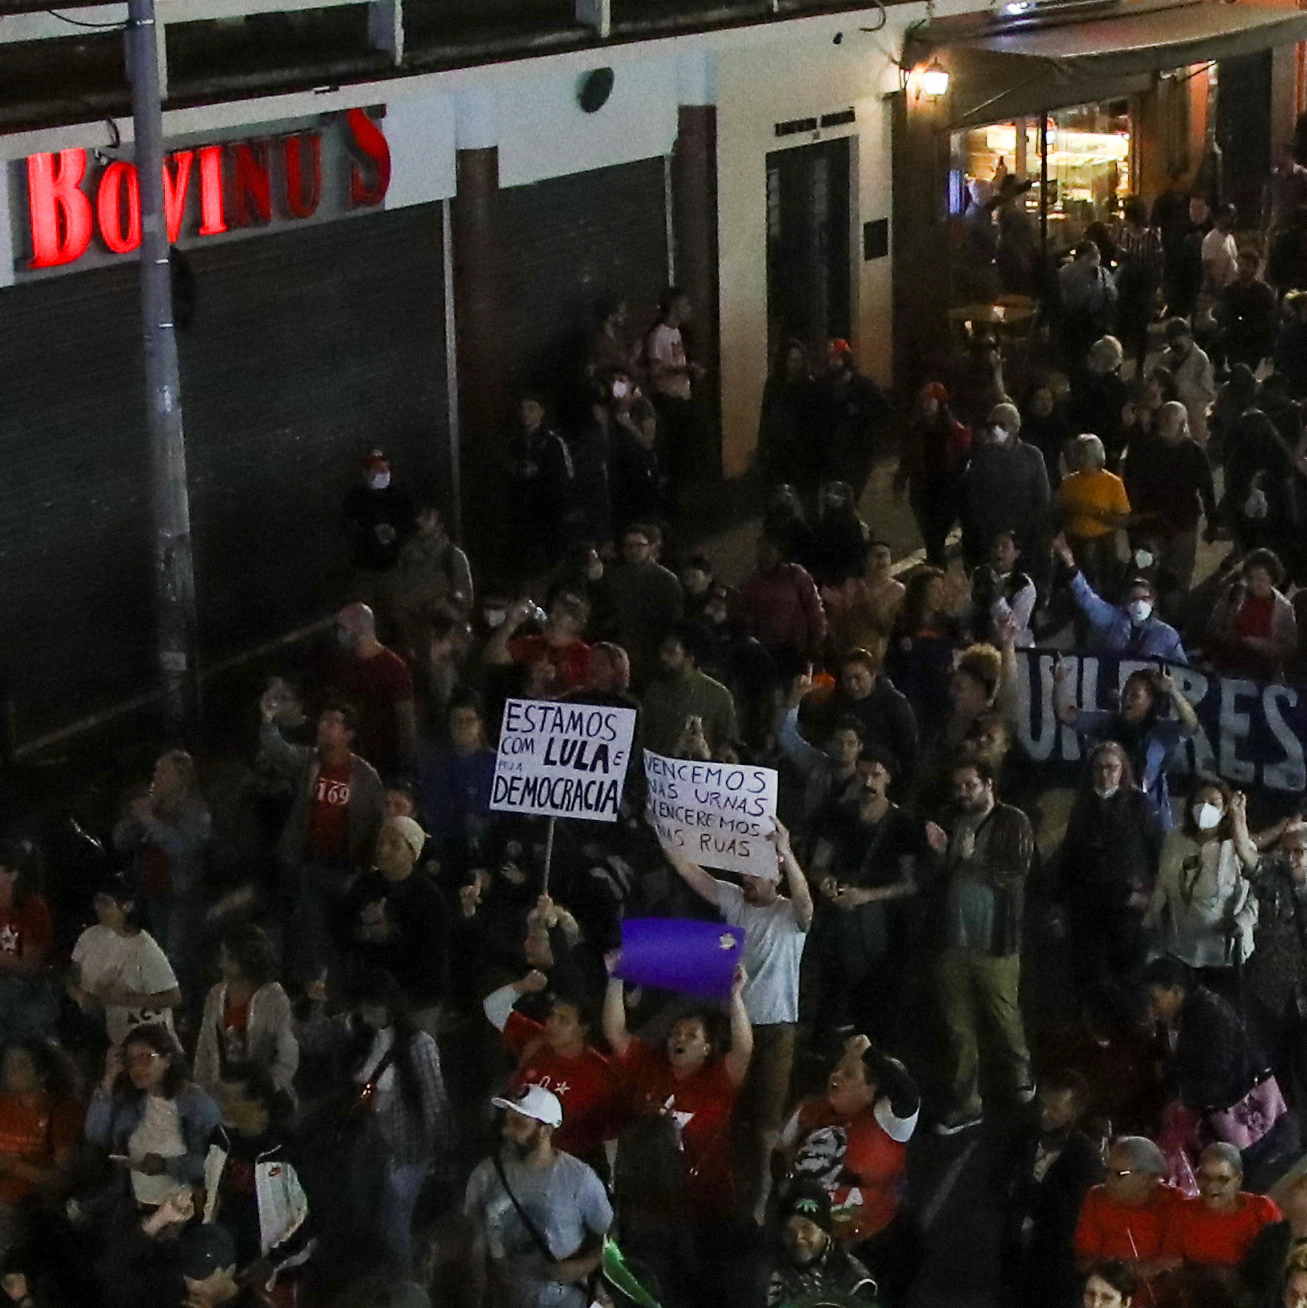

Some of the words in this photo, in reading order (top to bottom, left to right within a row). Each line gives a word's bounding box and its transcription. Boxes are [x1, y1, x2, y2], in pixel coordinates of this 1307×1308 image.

[506, 703, 618, 742] ESTAMOS
[501, 736, 535, 755] COM
[542, 737, 609, 774] LULA
[645, 756, 766, 794] VENCEMOS
[493, 775, 619, 815] DEMOCRACIA
[694, 788, 769, 817] URNAS
[699, 832, 751, 858] RUAS
